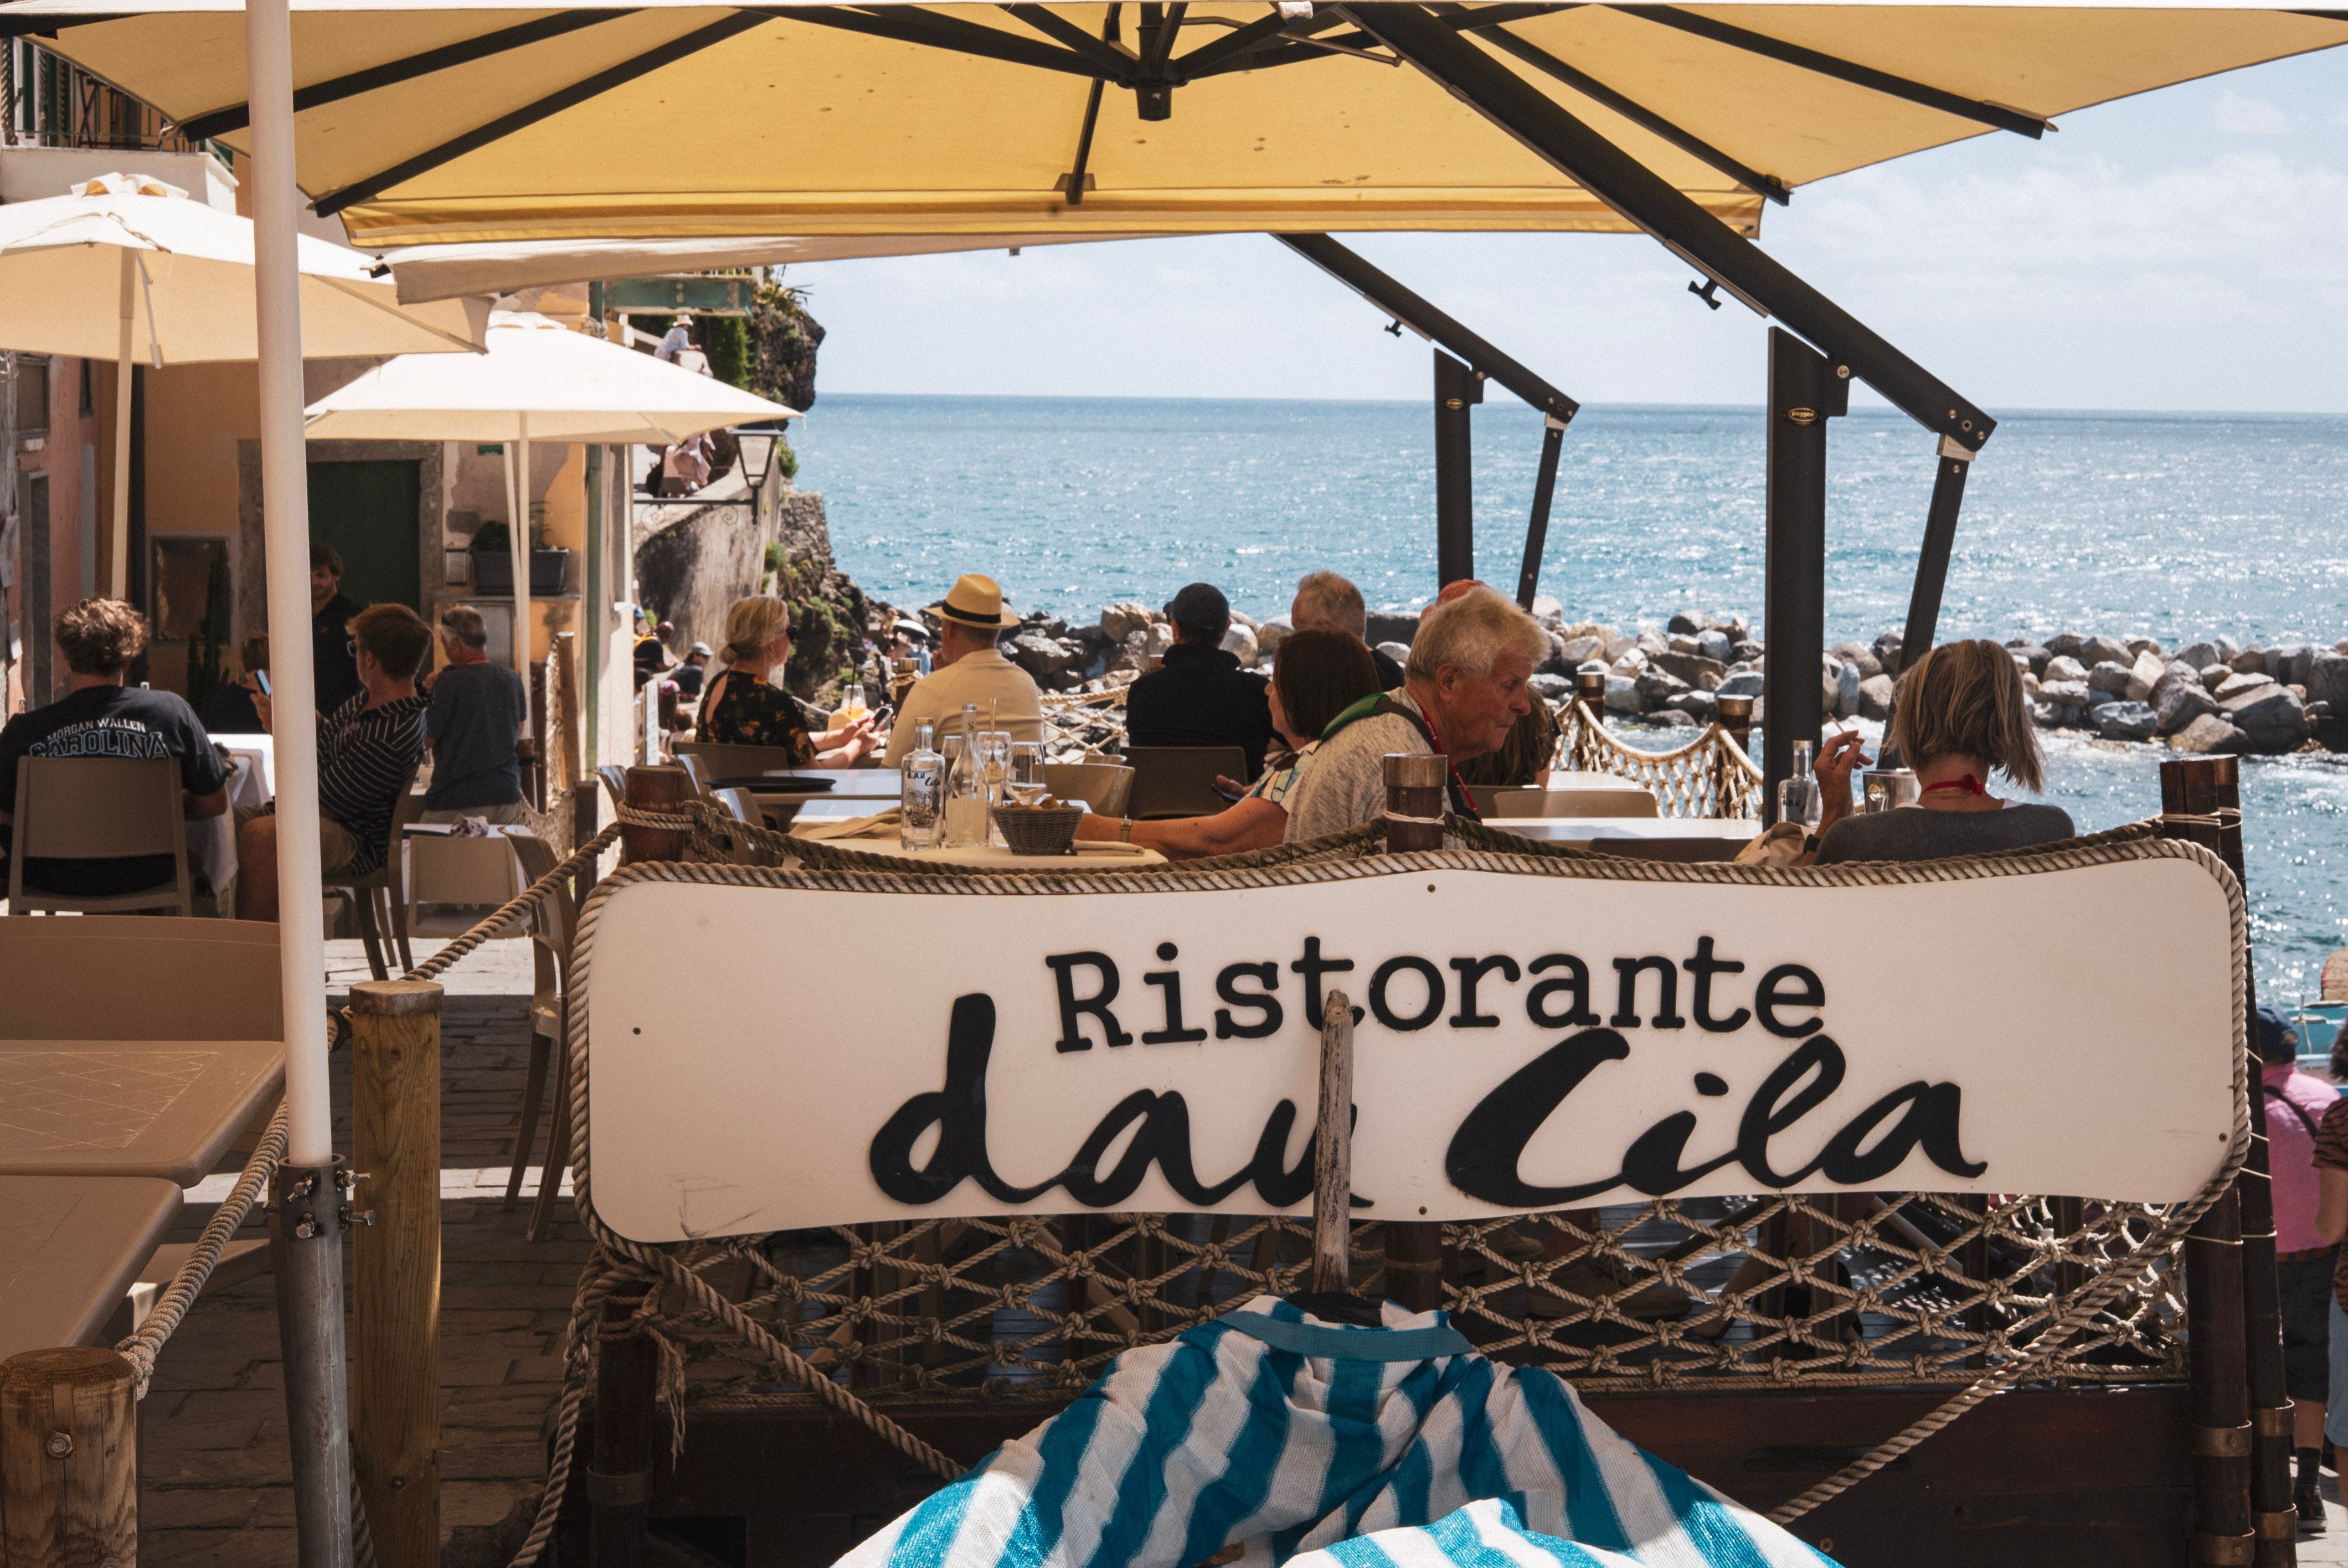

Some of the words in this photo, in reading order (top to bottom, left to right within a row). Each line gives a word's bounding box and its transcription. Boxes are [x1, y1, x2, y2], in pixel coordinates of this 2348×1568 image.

[29, 729, 172, 759] CAROLINA
[47, 721, 93, 741] MORGAN
[97, 718, 146, 733] WALLEN
[1045, 936, 1826, 1053] Ristorante
[1445, 1026, 1989, 1208] Cila
